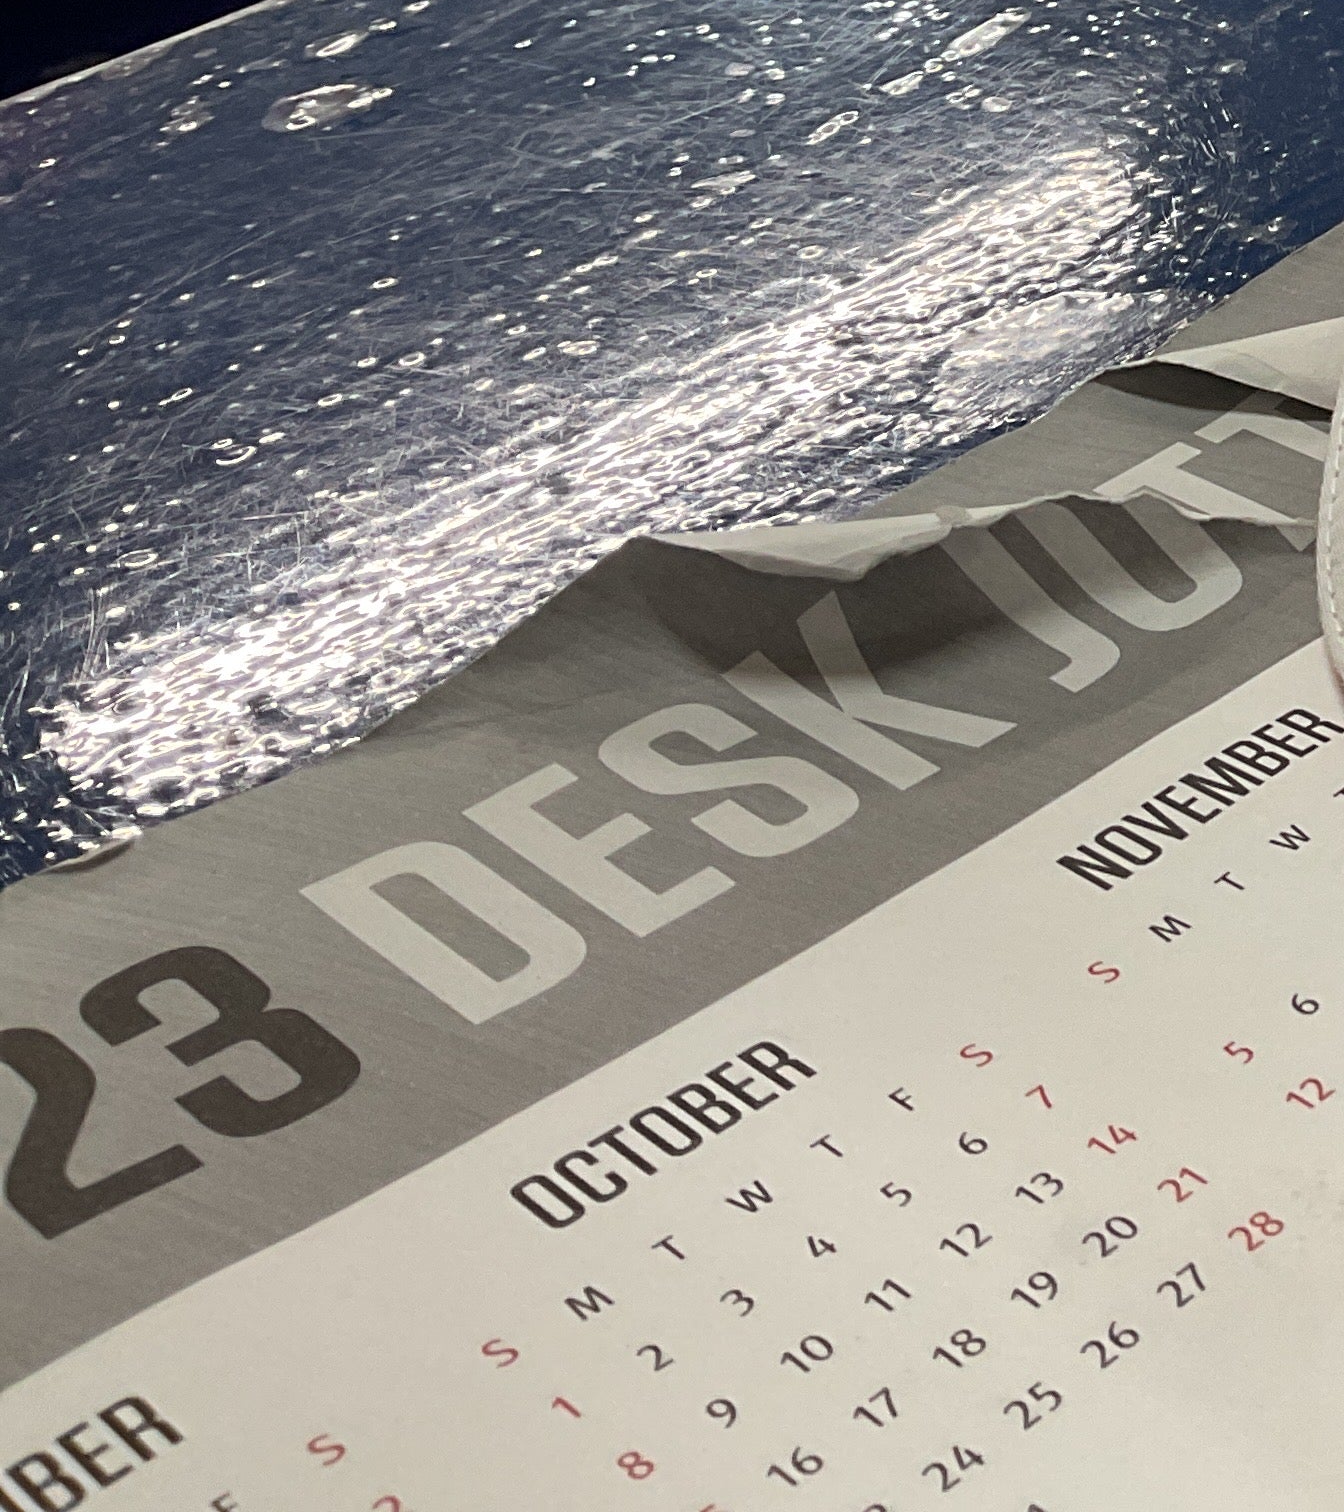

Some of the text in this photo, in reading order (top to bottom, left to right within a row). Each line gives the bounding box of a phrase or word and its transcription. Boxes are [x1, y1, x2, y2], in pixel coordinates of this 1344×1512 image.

[300, 591, 1017, 1025] DESK
[1088, 961, 1120, 983] S
[1148, 915, 1192, 943] M
[1214, 871, 1245, 891] T
[1269, 824, 1311, 850] W
[509, 1040, 818, 1230] OCTOBER
[1223, 1041, 1254, 1064] 5
[1291, 994, 1319, 1015] 6
[1286, 1078, 1335, 1108] 12
[482, 1044, 993, 1367] S M T W T F S
[552, 1085, 1052, 1418] 1 2 3 4 5 6 7
[617, 1125, 1137, 1480] 8 9 10 11 12 13 14
[767, 1167, 1208, 1486] 16 17 18 19 20 21
[922, 1211, 1284, 1492] 24 25 26 27 28
[0, 1396, 184, 1512] BER
[307, 1434, 346, 1466] S
